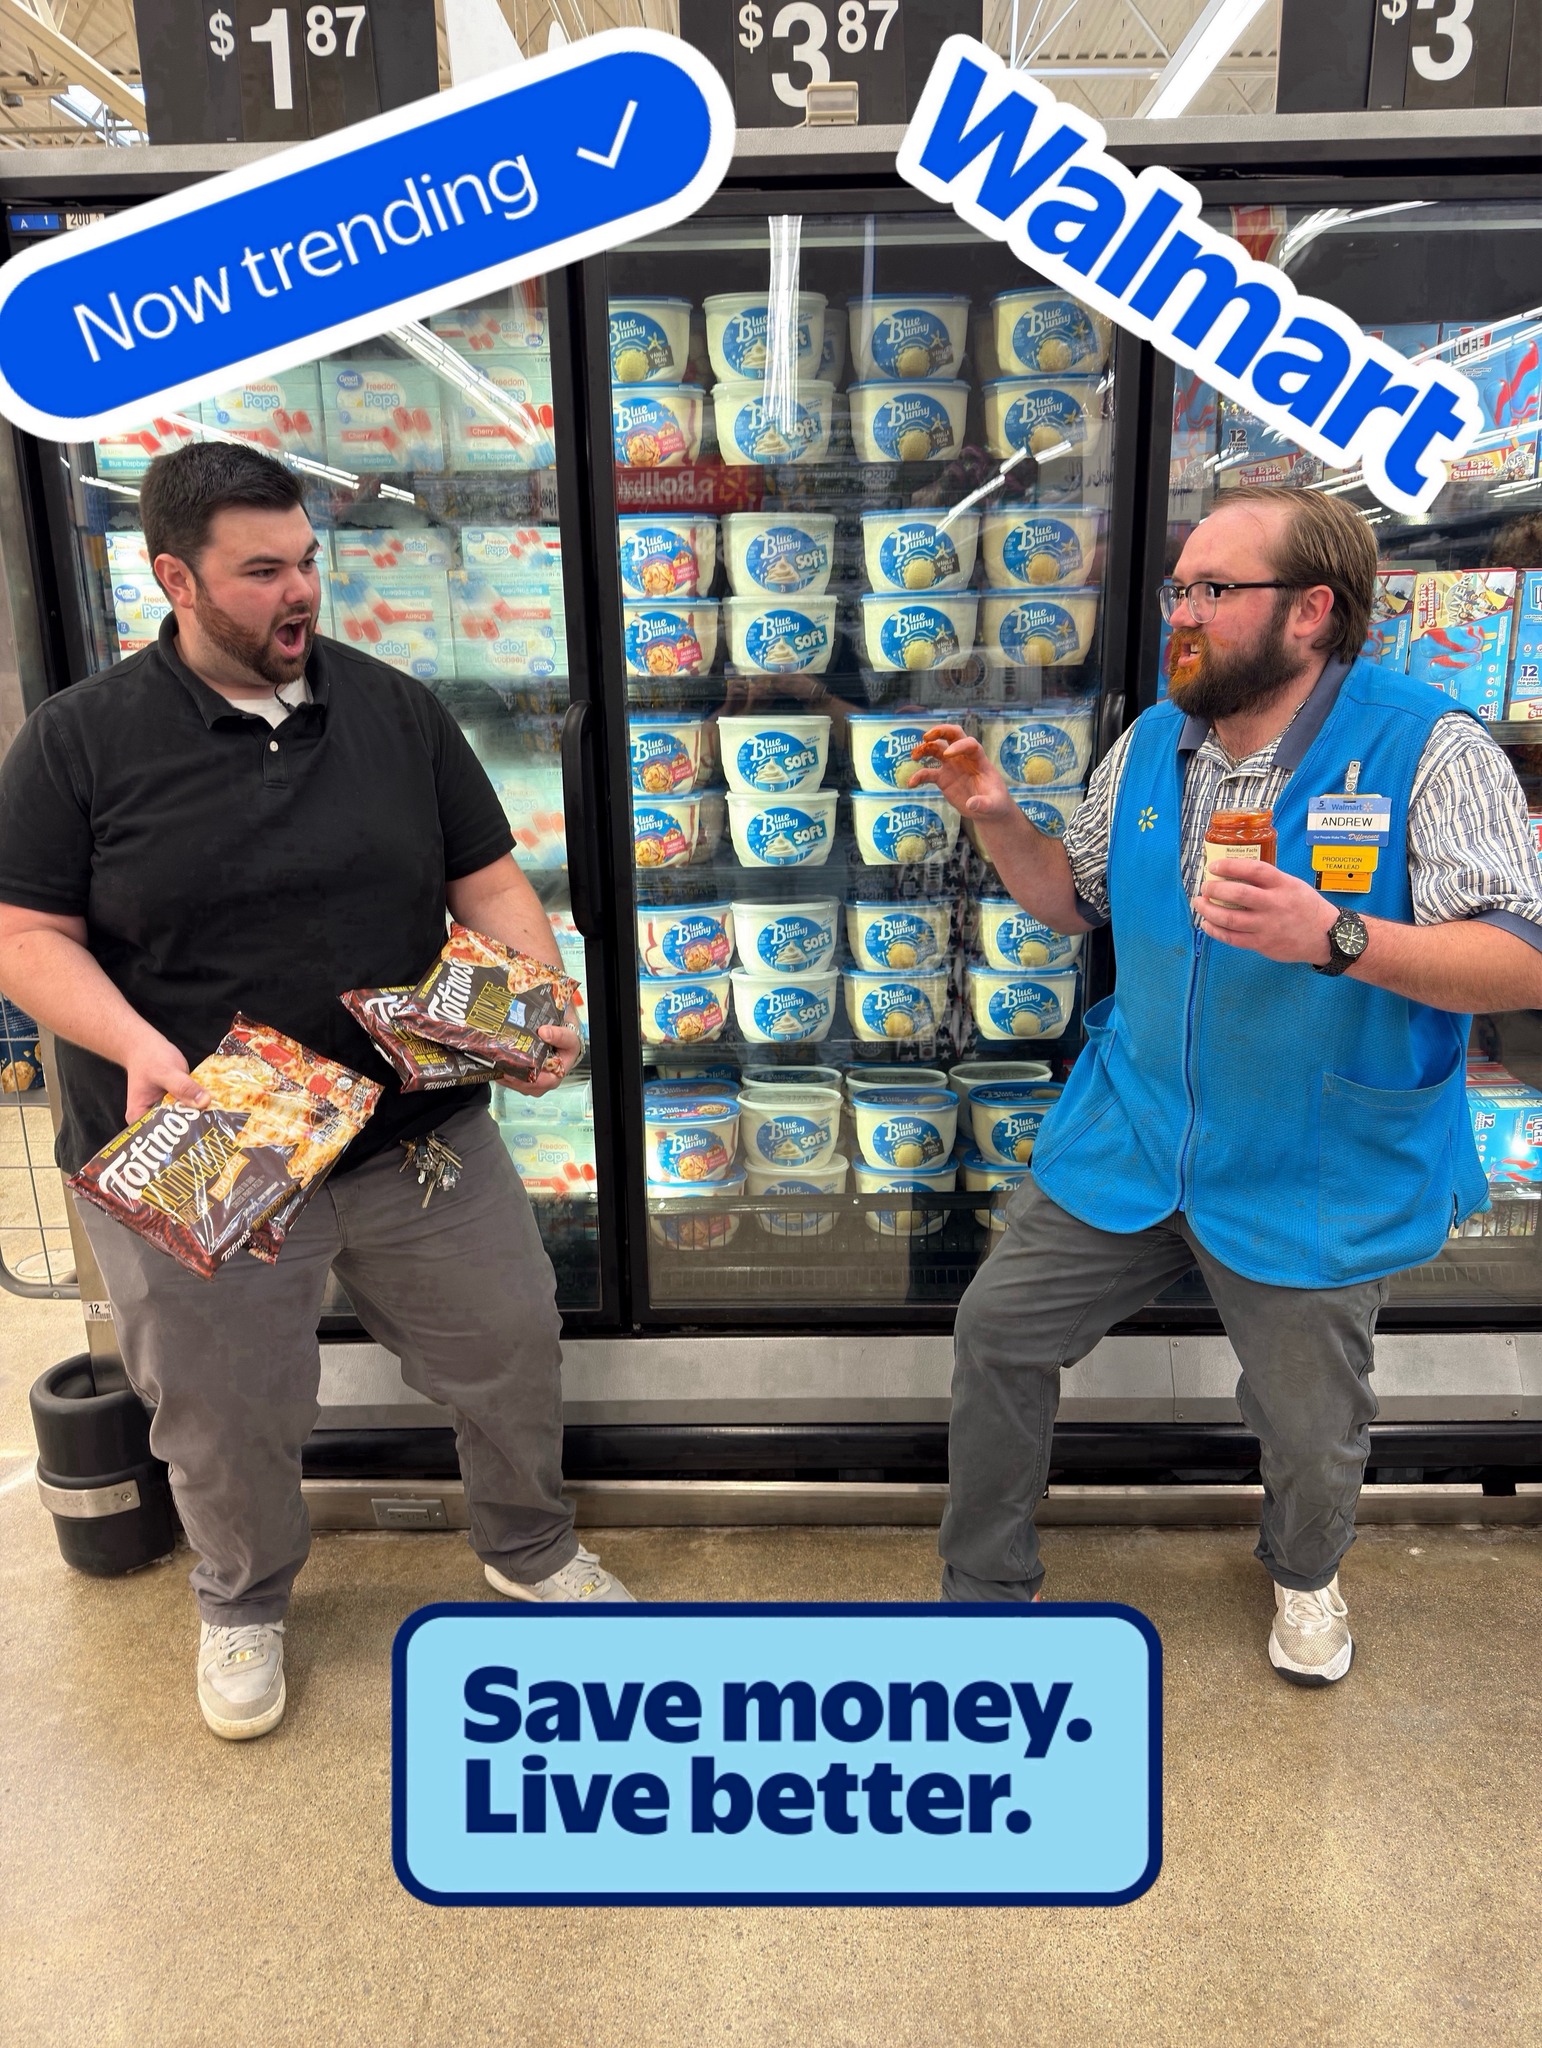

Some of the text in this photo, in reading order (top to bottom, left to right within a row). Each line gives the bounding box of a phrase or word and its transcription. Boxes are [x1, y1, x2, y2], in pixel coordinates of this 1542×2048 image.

[306, 6, 366, 58] 87
[838, 1, 899, 51] 87
[21, 219, 28, 229] A
[884, 317, 920, 335] Blue
[1025, 308, 1062, 328] Blue
[884, 325, 929, 344] Bunny
[1025, 316, 1071, 337] Bunny
[243, 391, 280, 410] Pops
[364, 392, 399, 408] Pops
[1017, 396, 1053, 415] Blue
[614, 405, 647, 424] Blue
[884, 400, 921, 418] Blue
[884, 407, 930, 426] Bunny
[1017, 403, 1062, 423] Bunny
[614, 413, 657, 433] Bunny
[473, 428, 494, 436] Cherry
[1230, 430, 1246, 441] 12
[1258, 466, 1281, 475] Epic
[1453, 467, 1497, 479] Summer
[1242, 474, 1286, 485] Summer
[890, 530, 925, 548] Blue
[1016, 525, 1052, 542] Blue
[1016, 532, 1060, 550] Bunny
[628, 534, 662, 552] Blue
[758, 534, 792, 551] Blue
[758, 541, 801, 559] Bunny
[890, 537, 934, 556] Bunny
[628, 541, 672, 561] Bunny
[1427, 578, 1436, 627] Summer
[143, 605, 171, 620] Pop
[890, 612, 925, 629] Blue
[1010, 608, 1047, 626] Blue
[631, 619, 666, 636] Blue
[757, 617, 790, 633] Blue
[757, 623, 799, 640] Bunny
[890, 619, 934, 637] Bunny
[1010, 615, 1055, 634] Bunny
[631, 625, 676, 644] Bunny
[375, 641, 410, 657] Pops
[494, 640, 528, 655] Pops
[1522, 666, 1537, 677] 12
[882, 734, 916, 750] Blue
[1012, 729, 1046, 744] Blue
[1012, 735, 1054, 751] Bunny
[631, 738, 663, 754] Blue
[747, 737, 781, 753] Blue
[747, 743, 789, 761] Bunny
[631, 745, 672, 762] Bunny
[756, 813, 790, 828] Blue
[883, 810, 917, 826] Blue
[883, 817, 925, 834] Bunny
[1321, 817, 1373, 827] ANDREW
[756, 819, 798, 836] Bunny
[1348, 833, 1379, 841] Difference
[673, 922, 703, 937] Blue
[768, 923, 800, 937] Blue
[876, 919, 908, 934] Blue
[876, 925, 916, 941] Bunny
[673, 928, 711, 945] Bunny
[768, 929, 808, 944] Bunny
[427, 957, 474, 1027] Totino's
[665, 992, 696, 1007] Blue
[763, 993, 796, 1007] Blue
[872, 989, 904, 1003] Blue
[1000, 988, 1033, 1002] Blue
[665, 998, 703, 1014] Bunny
[763, 998, 804, 1014] Bunny
[872, 994, 912, 1010] Bunny
[1000, 994, 1040, 1009] Bunny
[767, 1121, 797, 1134] Blue
[883, 1122, 913, 1135] Blue
[1002, 1117, 1034, 1131] Blue
[667, 1134, 699, 1148] Blue
[767, 1126, 805, 1141] Bunny
[883, 1127, 921, 1141] Bunny
[667, 1139, 706, 1154] Bunny
[538, 1151, 569, 1164] Pops
[89, 1303, 101, 1314] 12
